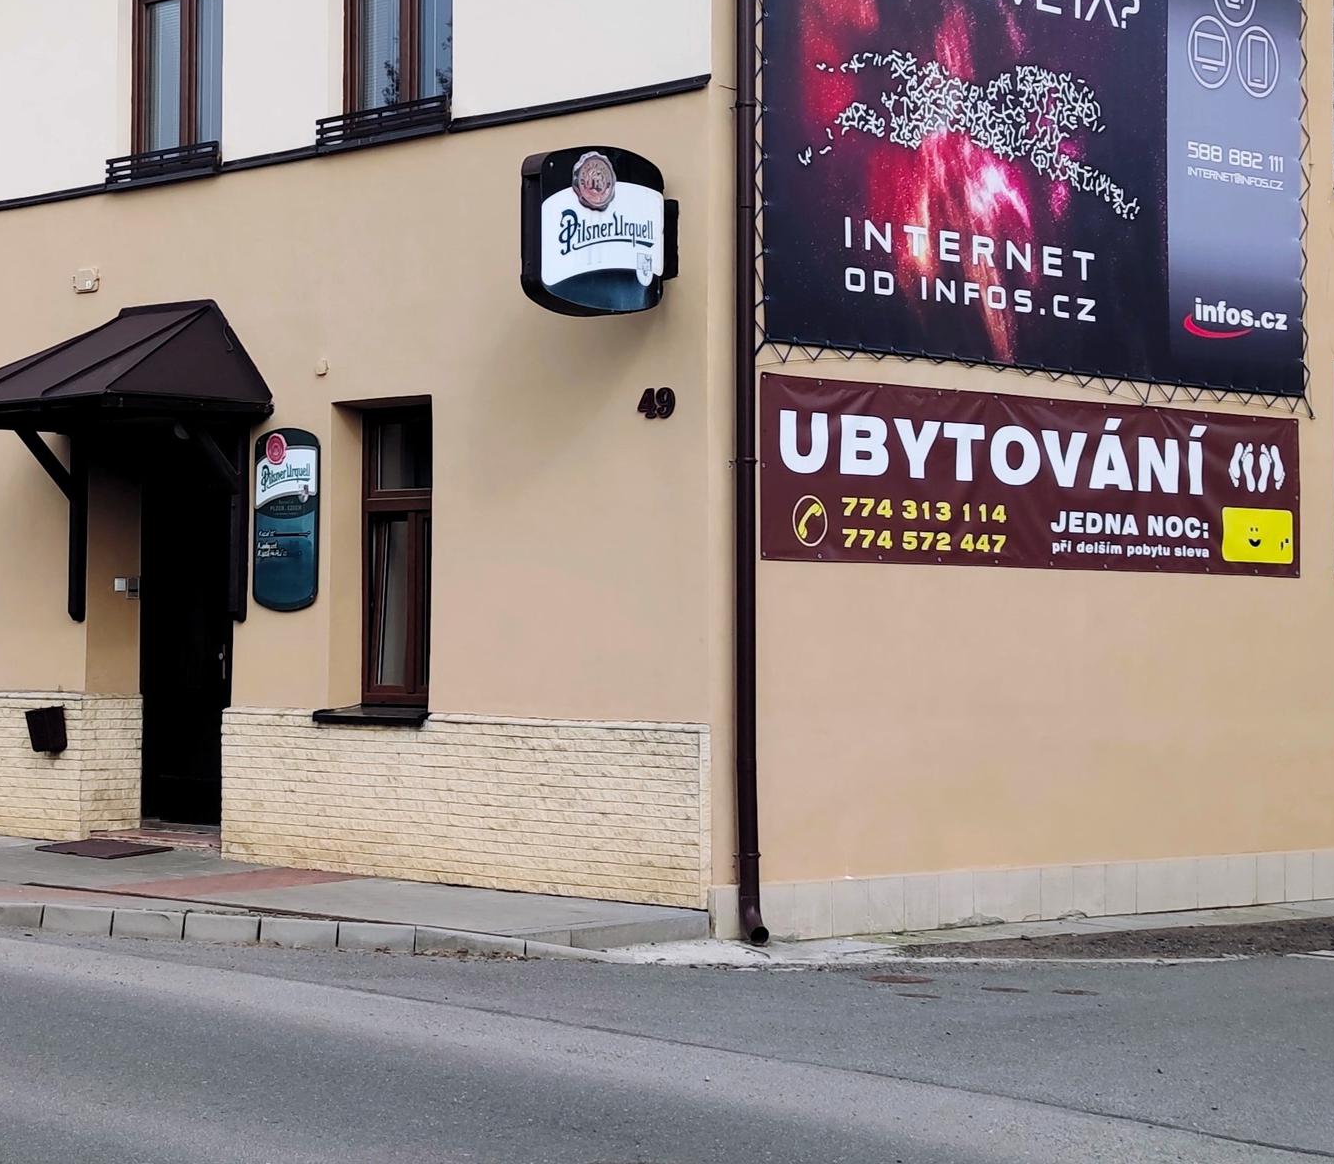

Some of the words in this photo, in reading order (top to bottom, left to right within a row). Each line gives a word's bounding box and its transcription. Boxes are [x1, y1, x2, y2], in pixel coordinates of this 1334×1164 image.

[1187, 141, 1223, 163] 588
[1228, 150, 1263, 170] 882
[1268, 155, 1284, 173] 111
[1187, 166, 1284, 191] INTERNET@INFOS.CZ
[558, 209, 614, 256] Pilsner
[612, 211, 654, 248] Urquell
[844, 216, 1096, 281] INTERNET
[845, 267, 895, 296] OD
[921, 276, 1097, 322] INFOS.CZ
[1194, 297, 1288, 331] infos.cz
[637, 386, 676, 419] 49
[778, 409, 1209, 496] UBYTOVÁNÍ
[841, 496, 893, 519] 774
[901, 499, 953, 522] 313
[961, 503, 1008, 524] 114
[1050, 510, 1139, 536] JEDNA
[1147, 515, 1210, 539] NOC:
[841, 528, 893, 549] 774
[901, 530, 952, 552] 572
[960, 533, 1008, 554] 447
[1051, 540, 1072, 555] při
[1077, 541, 1123, 555] delším
[1126, 544, 1172, 559] pobytu
[1174, 545, 1210, 558] sleva
